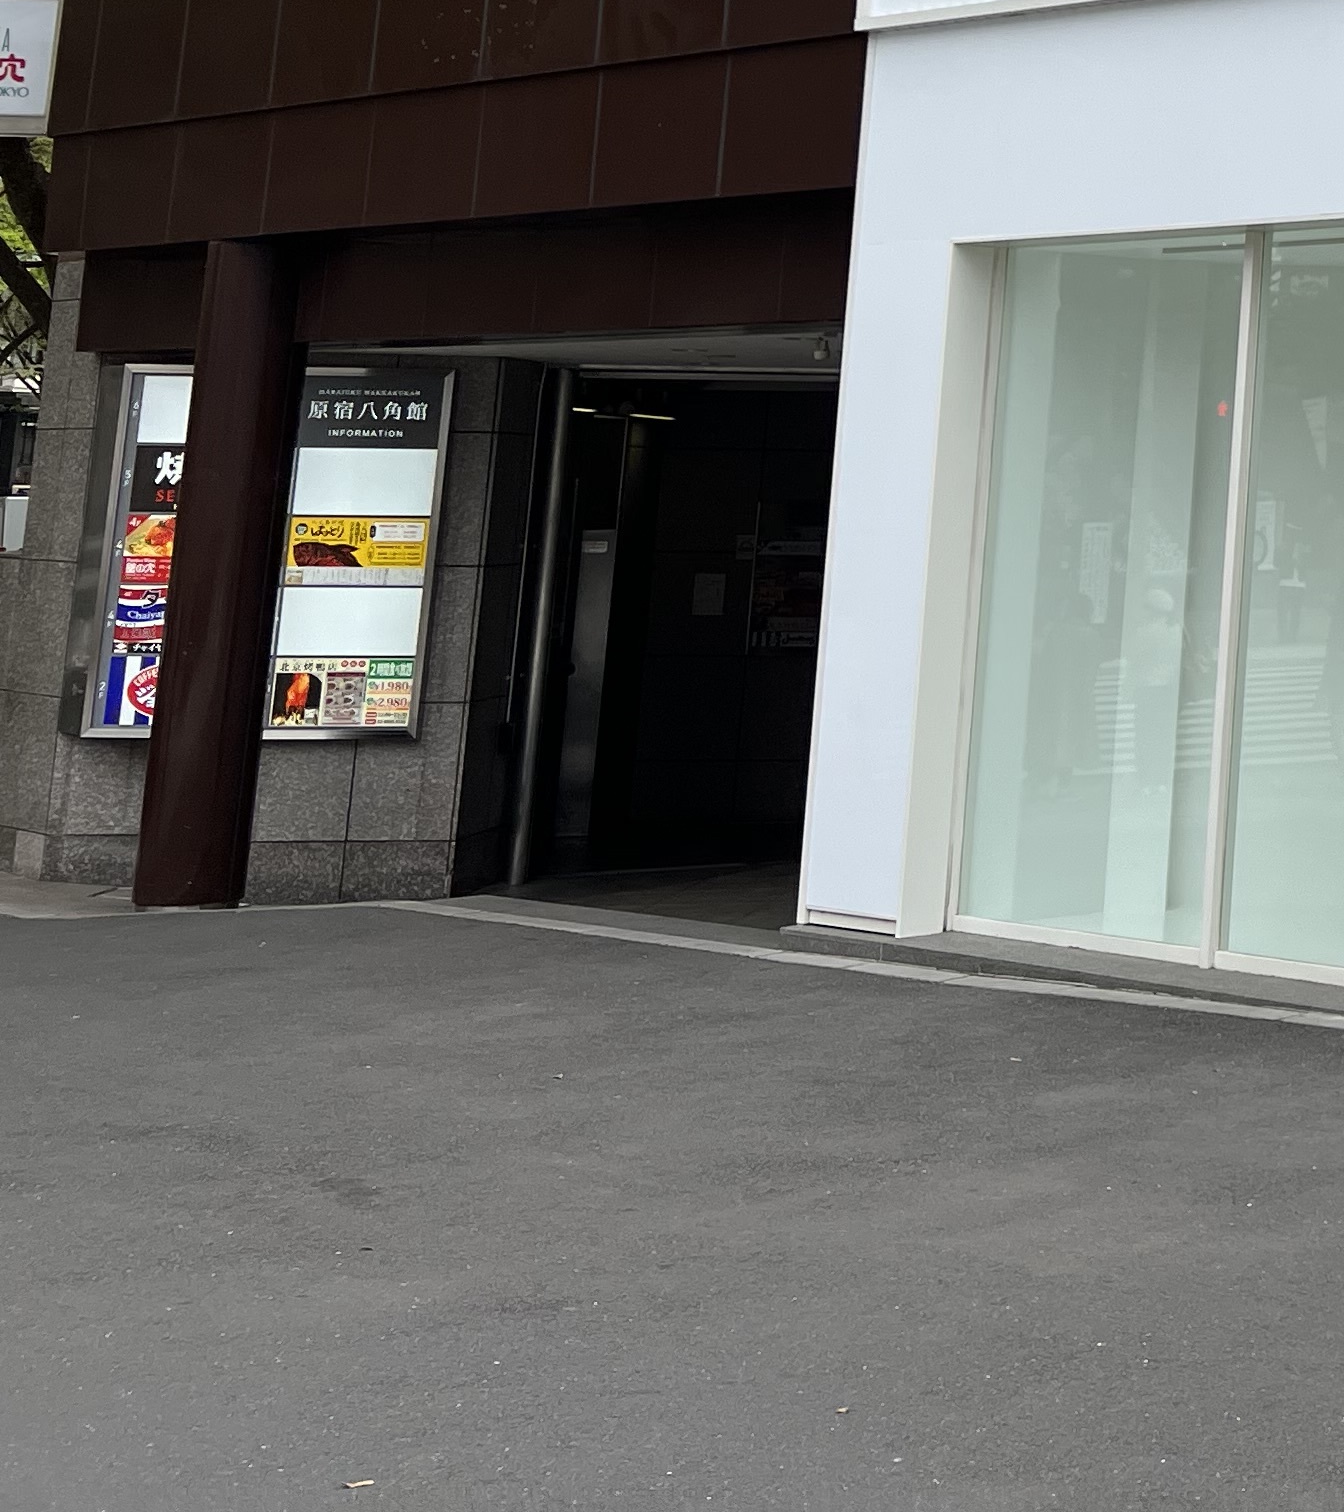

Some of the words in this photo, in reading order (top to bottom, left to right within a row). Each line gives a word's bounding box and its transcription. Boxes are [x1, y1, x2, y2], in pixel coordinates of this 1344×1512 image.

[0, 86, 30, 98] KYO
[307, 400, 429, 421] 原宿八角館
[327, 429, 404, 438] INFORMATION
